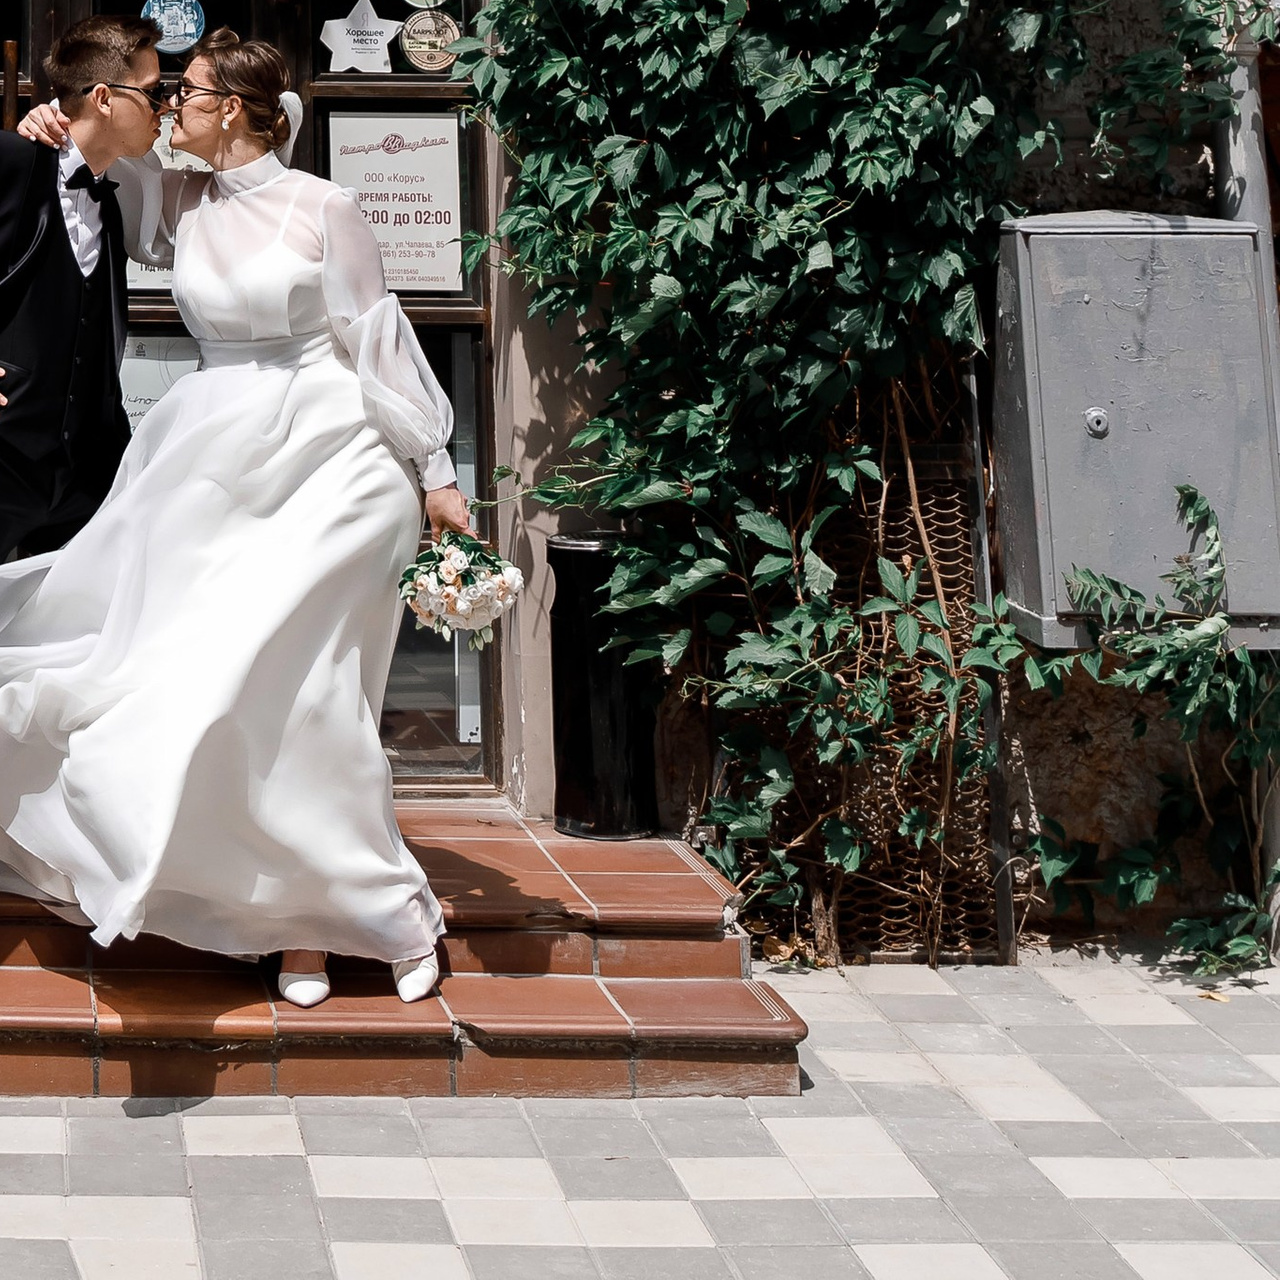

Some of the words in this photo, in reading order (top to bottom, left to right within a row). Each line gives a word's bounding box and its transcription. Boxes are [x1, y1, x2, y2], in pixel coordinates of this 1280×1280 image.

[361, 12, 369, 27] Я
[345, 27, 385, 38] Хорошее
[364, 172, 384, 183] ООО
[387, 172, 425, 184] «Корус»
[358, 192, 389, 202] ВРЕМЯ
[392, 192, 433, 203] РАБОТЫ:
[393, 213, 410, 227] до
[414, 210, 451, 225] 02:00
[436, 240, 445, 249] 85
